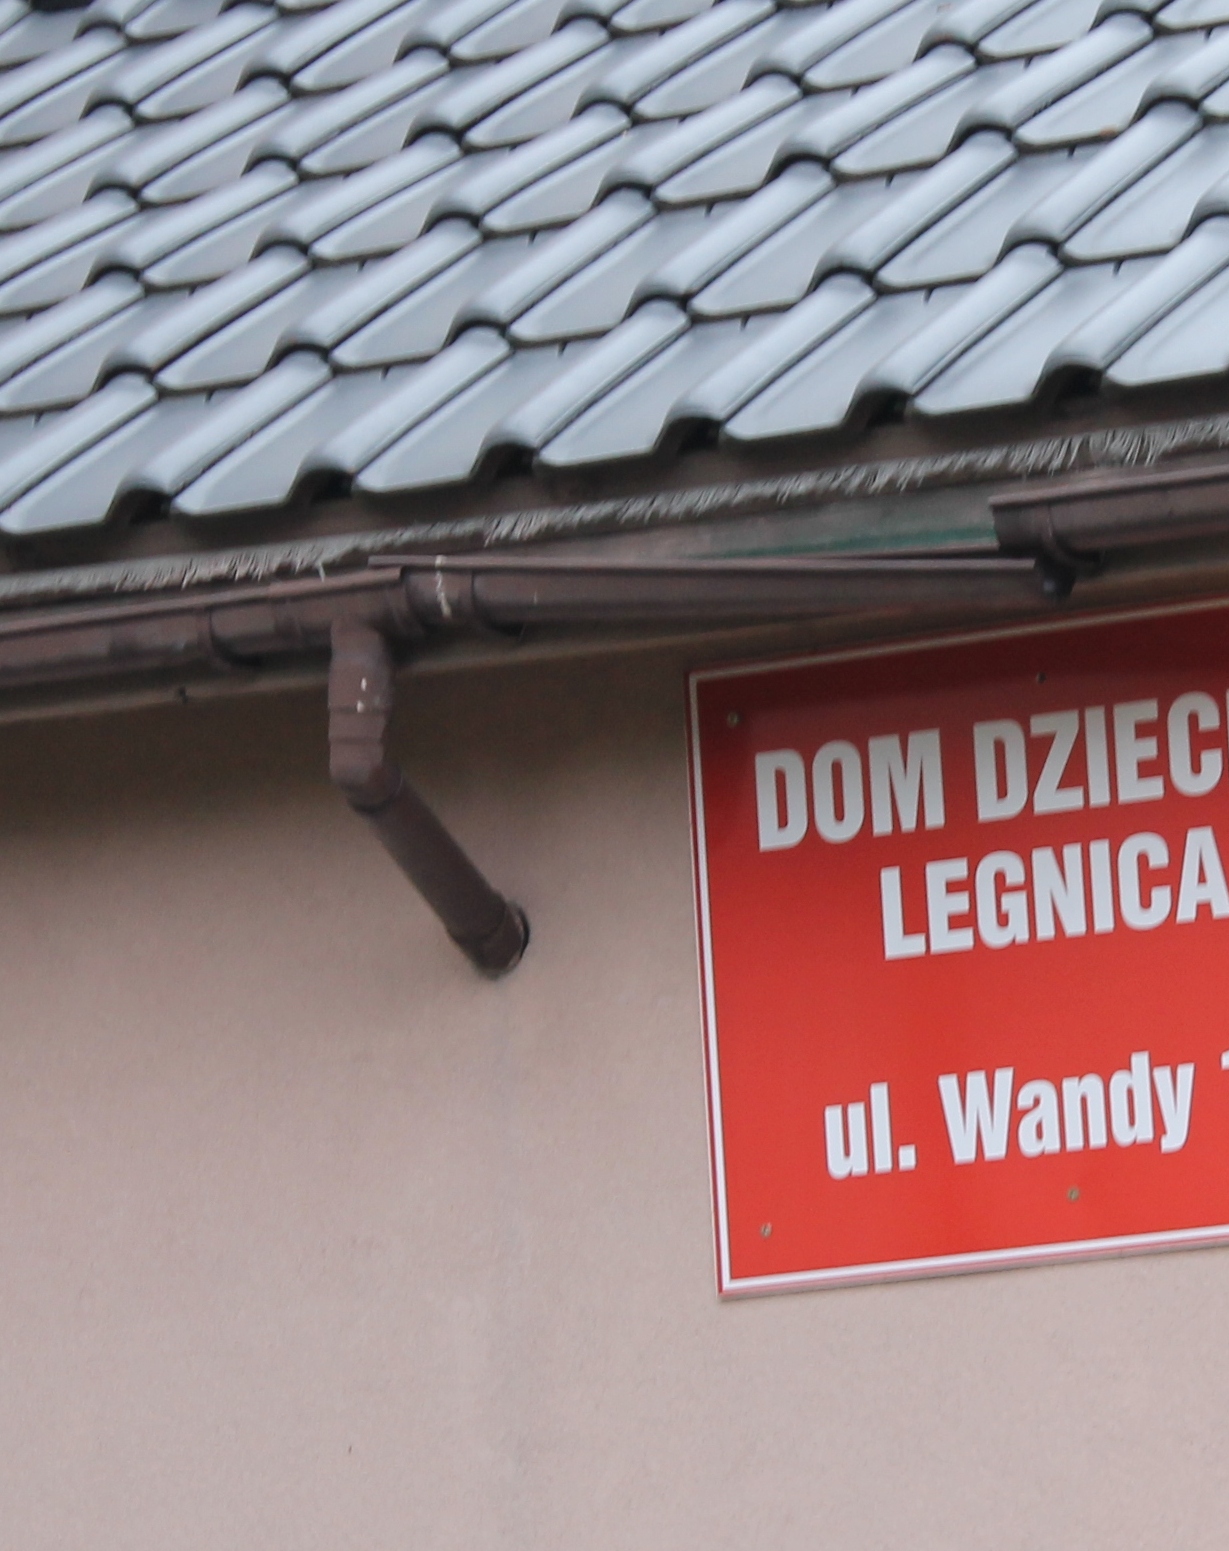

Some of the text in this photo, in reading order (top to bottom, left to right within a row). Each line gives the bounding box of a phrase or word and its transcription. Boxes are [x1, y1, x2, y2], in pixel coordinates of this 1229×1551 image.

[754, 727, 946, 853] DOM
[823, 1081, 918, 1180] ul.
[938, 1050, 1196, 1164] Wandy
